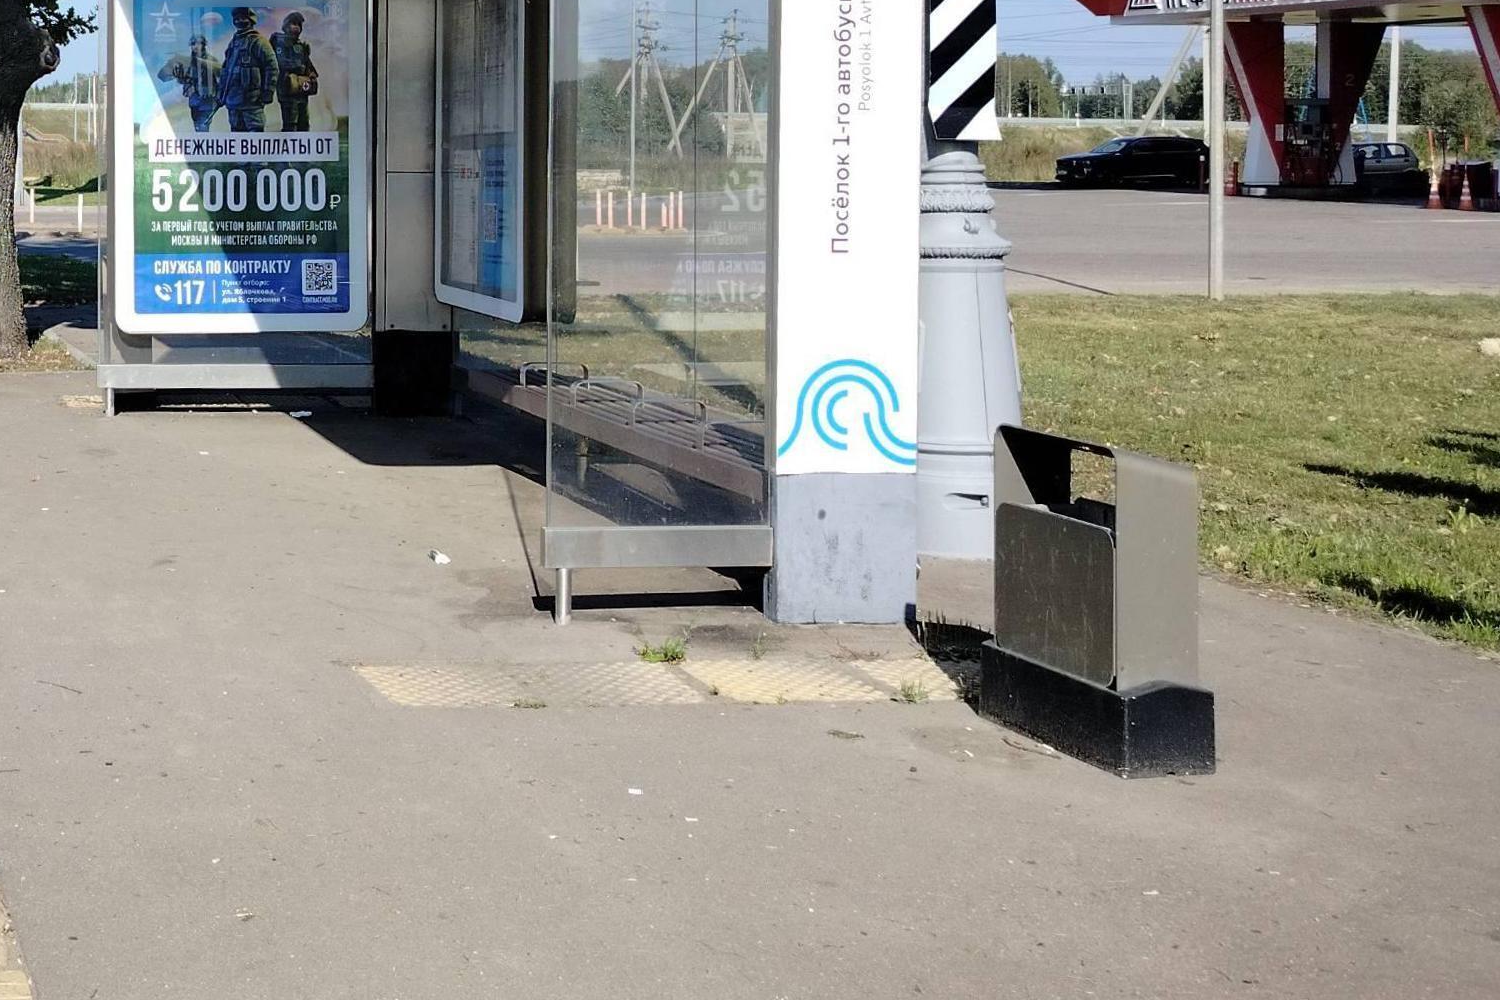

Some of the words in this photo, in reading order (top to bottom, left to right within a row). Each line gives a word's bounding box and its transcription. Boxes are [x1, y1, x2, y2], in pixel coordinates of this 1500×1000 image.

[858, 43, 874, 111] Posyolok
[832, 102, 851, 146] 1-го
[155, 138, 236, 157] ДЕНЕЖНЫЕ
[240, 138, 311, 156] ВЫПЛАТЫ
[315, 138, 333, 156] ОТ
[256, 168, 327, 212] 000
[831, 154, 850, 254] Посёлок
[151, 221, 162, 232] ЗА
[162, 219, 192, 232] ПЕРВЫЙ
[193, 221, 208, 233] ГОД
[209, 221, 215, 232] С
[215, 221, 245, 232] УЧЕТОМ
[246, 221, 275, 231] ВЫПЛАТ
[276, 220, 338, 231] ПРАВИТЕЛЬСТВА
[171, 235, 203, 246] МОСКВЫ
[204, 235, 210, 245] И
[211, 235, 268, 246] МИНИСТЕРСТВА
[269, 234, 305, 245] ОБОРОНЫ
[306, 234, 318, 245] РФ
[154, 260, 202, 275] СЛУЖБА
[205, 260, 221, 274] ПО
[224, 260, 291, 274] КОНТРАКТУ
[174, 280, 205, 305] 117
